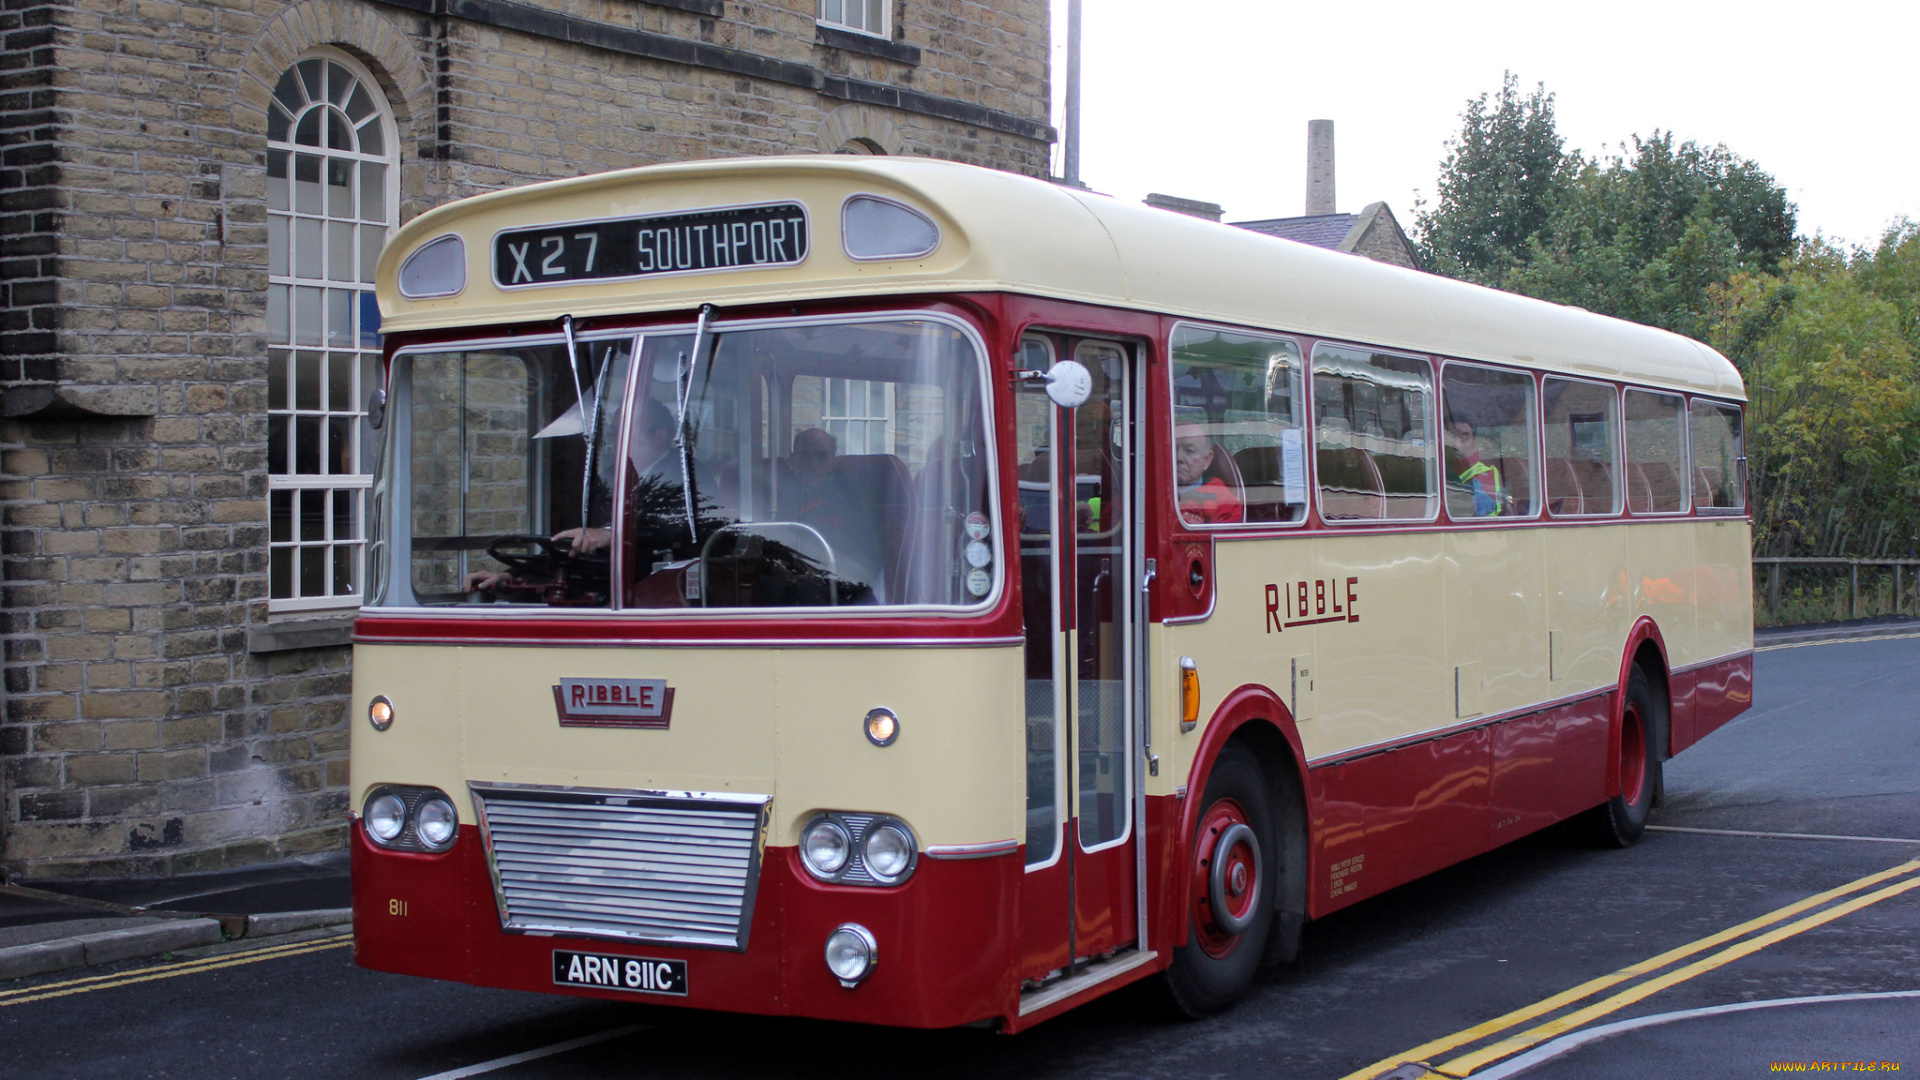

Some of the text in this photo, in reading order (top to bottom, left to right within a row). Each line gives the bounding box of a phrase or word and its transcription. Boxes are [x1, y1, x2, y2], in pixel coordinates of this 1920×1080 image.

[508, 217, 804, 284] X27 SOUTHPORT
[1265, 576, 1360, 634] RIBBLE
[571, 684, 654, 709] RIBBLE
[389, 898, 408, 917] 811
[568, 954, 672, 990] ARN 811C
